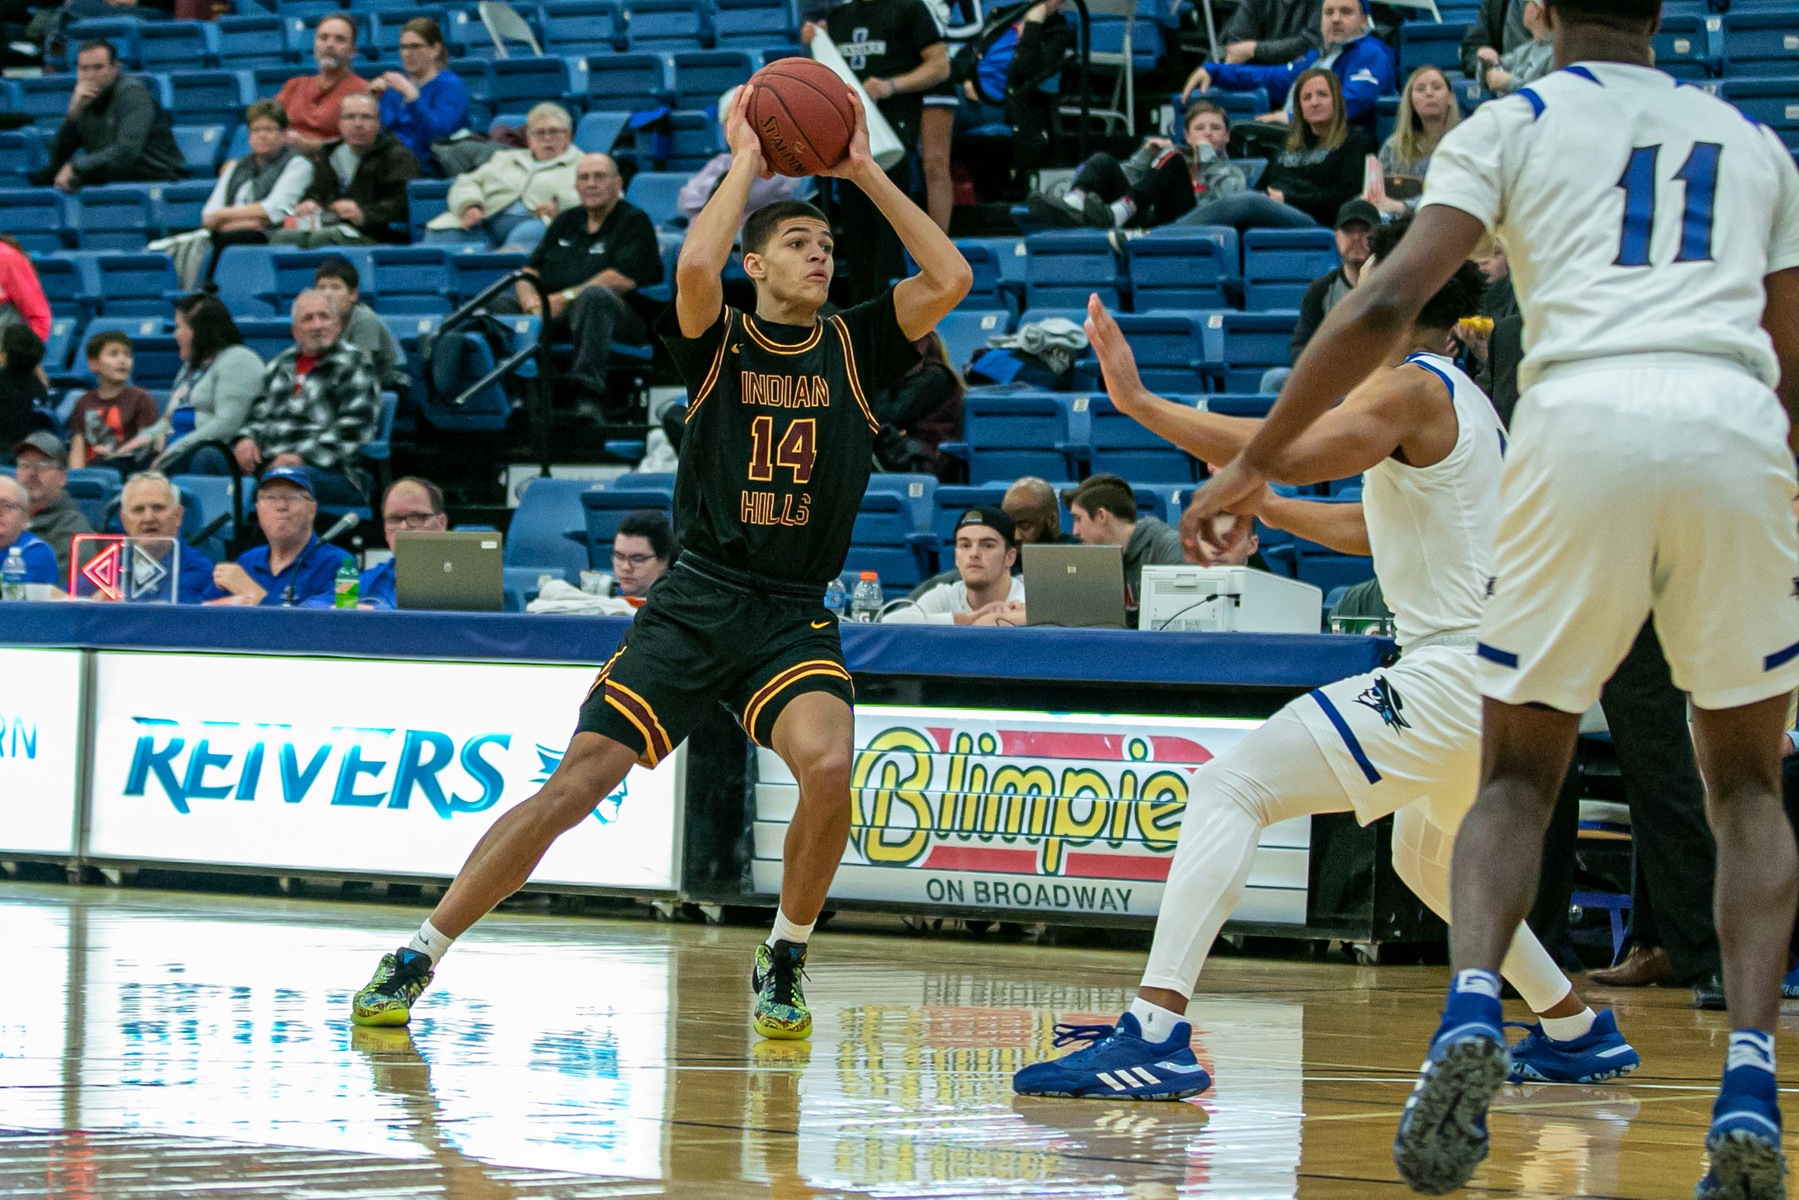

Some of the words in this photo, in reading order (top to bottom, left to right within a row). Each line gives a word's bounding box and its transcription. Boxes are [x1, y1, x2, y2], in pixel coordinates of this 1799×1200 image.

[761, 115, 807, 174] SPALDIN
[1610, 141, 1724, 267] 11
[741, 371, 830, 408] INDIAN
[748, 416, 817, 483] 14
[741, 490, 812, 526] HILLS
[122, 716, 512, 820] REIVERS
[850, 726, 1189, 875] Blimpie
[926, 878, 964, 903] ON
[974, 881, 1132, 912] BROADWAY
